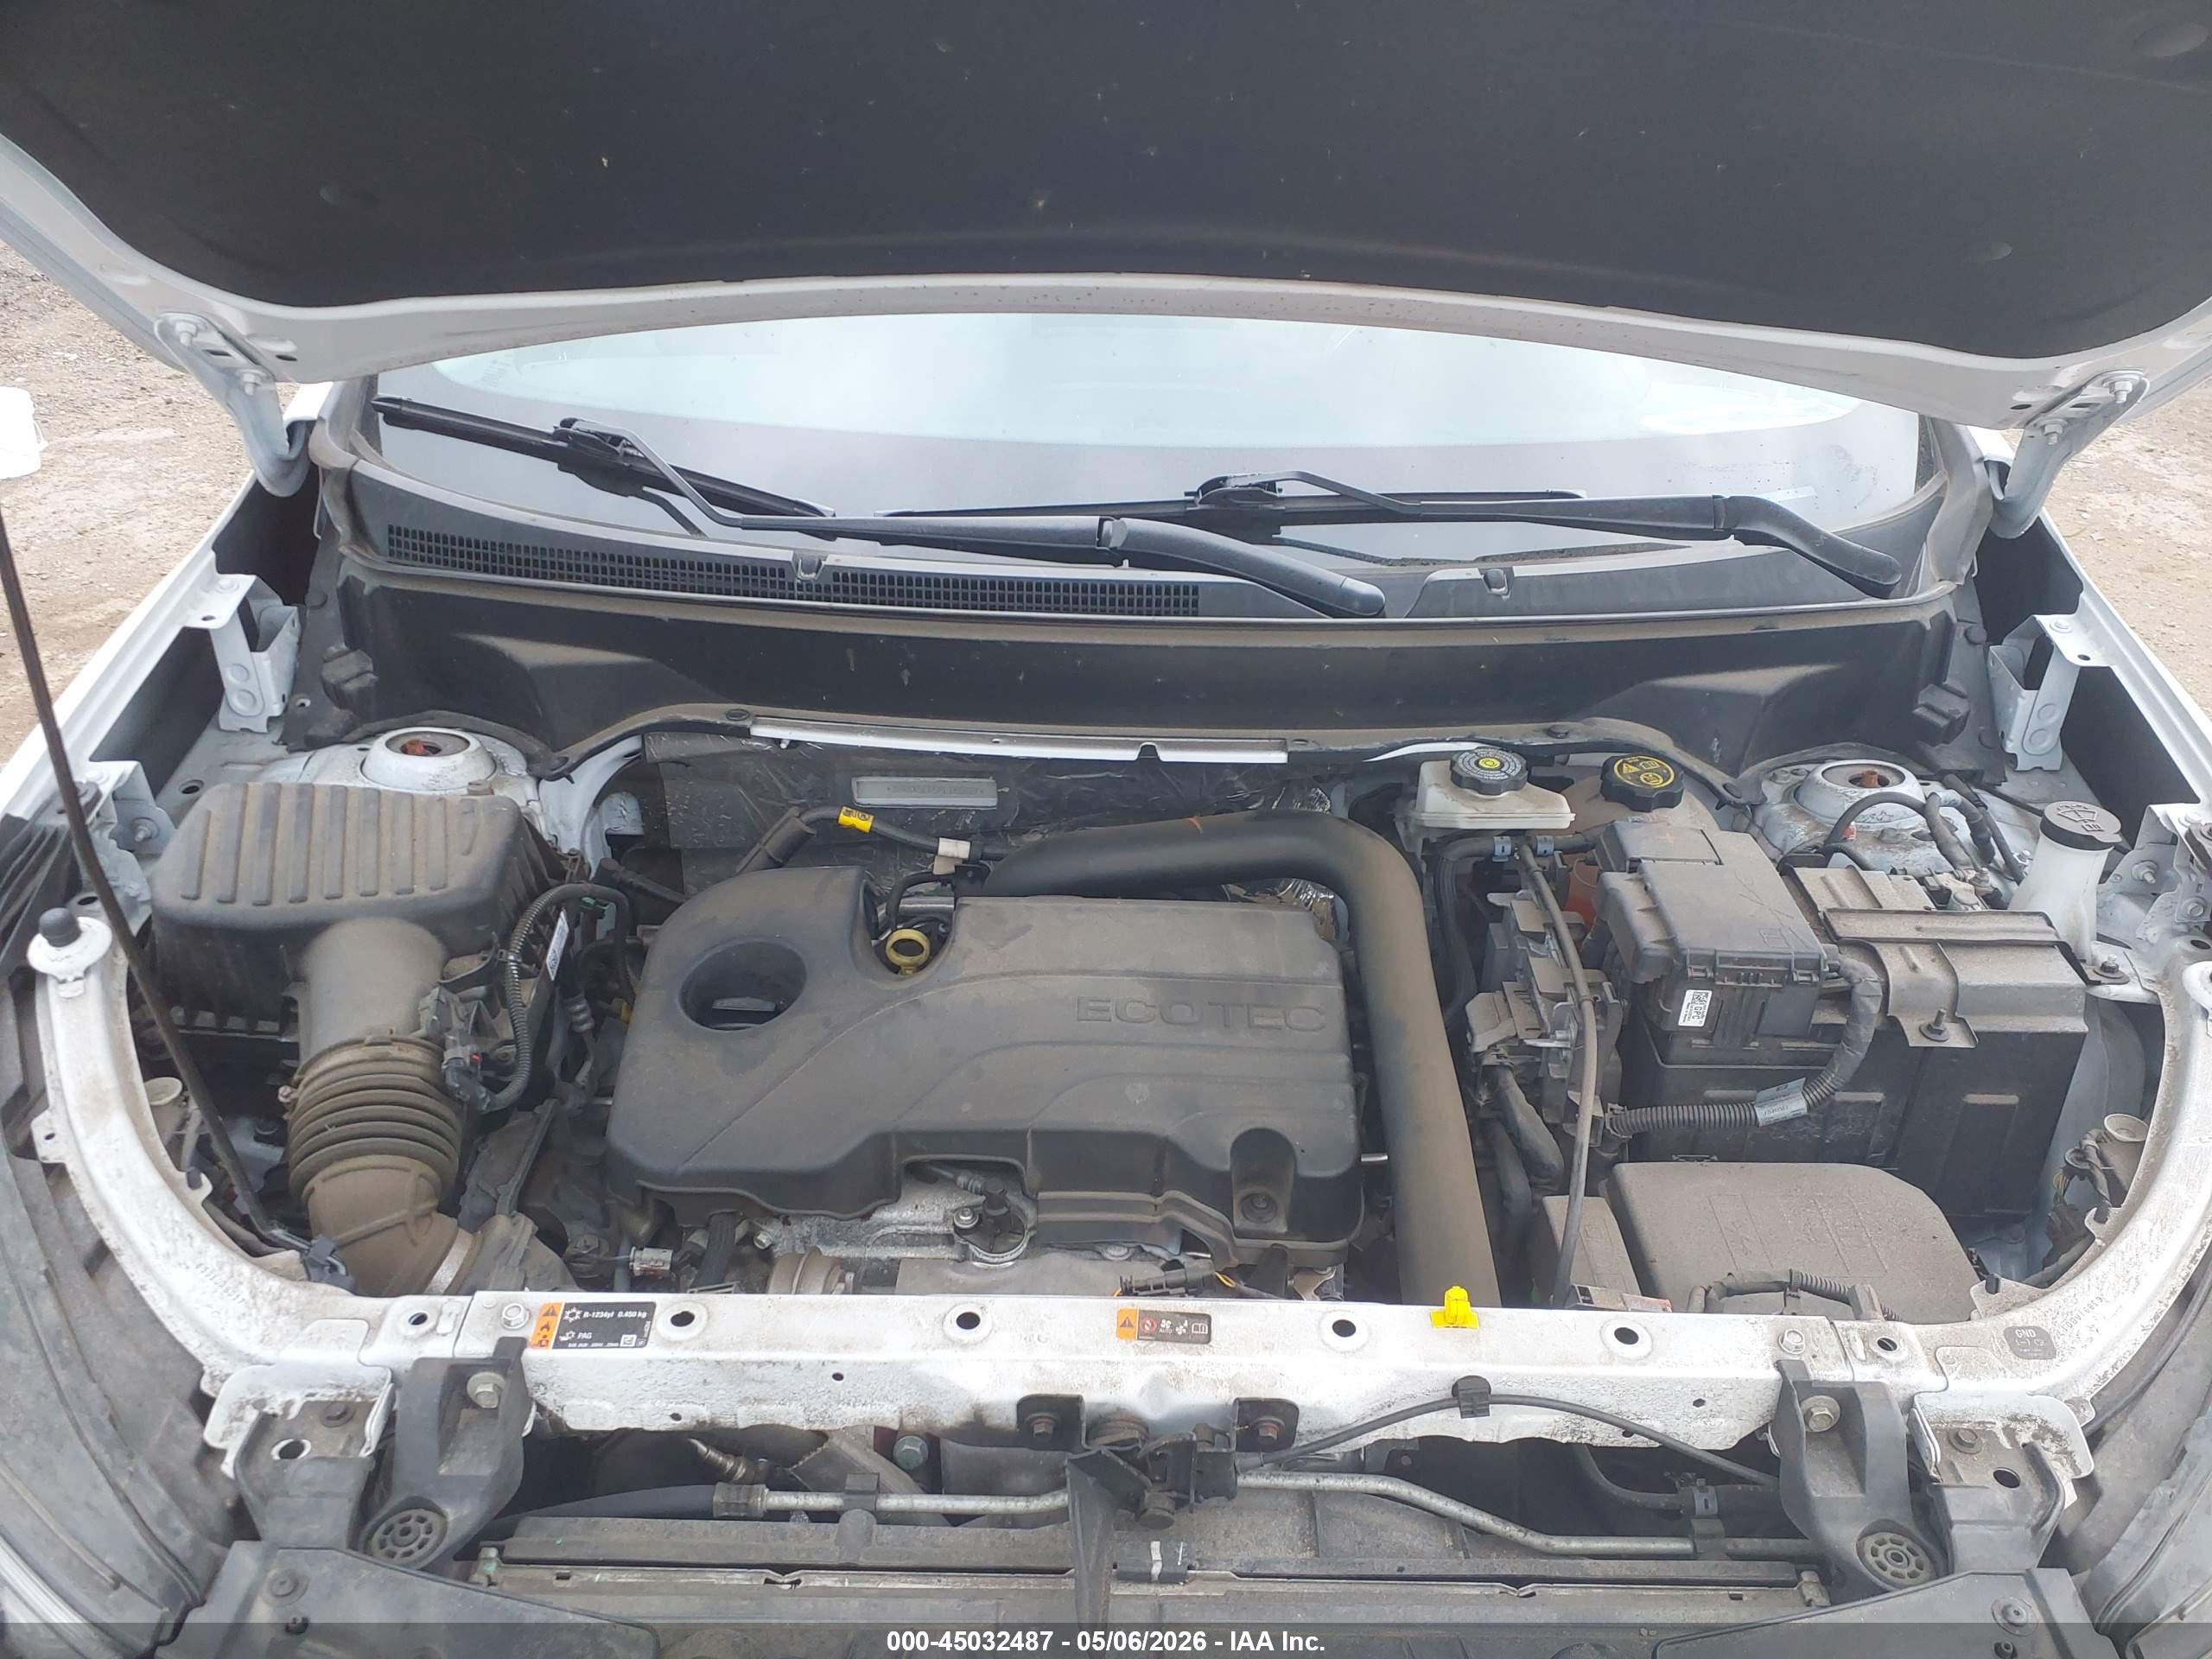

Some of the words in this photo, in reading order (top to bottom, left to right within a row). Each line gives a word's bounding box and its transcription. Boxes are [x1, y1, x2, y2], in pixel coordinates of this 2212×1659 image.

[1077, 995, 1326, 1032] ECOTEC
[582, 1311, 615, 1319] R-1234yf
[638, 1310, 648, 1319] kg
[2015, 1329, 2036, 1338] GND
